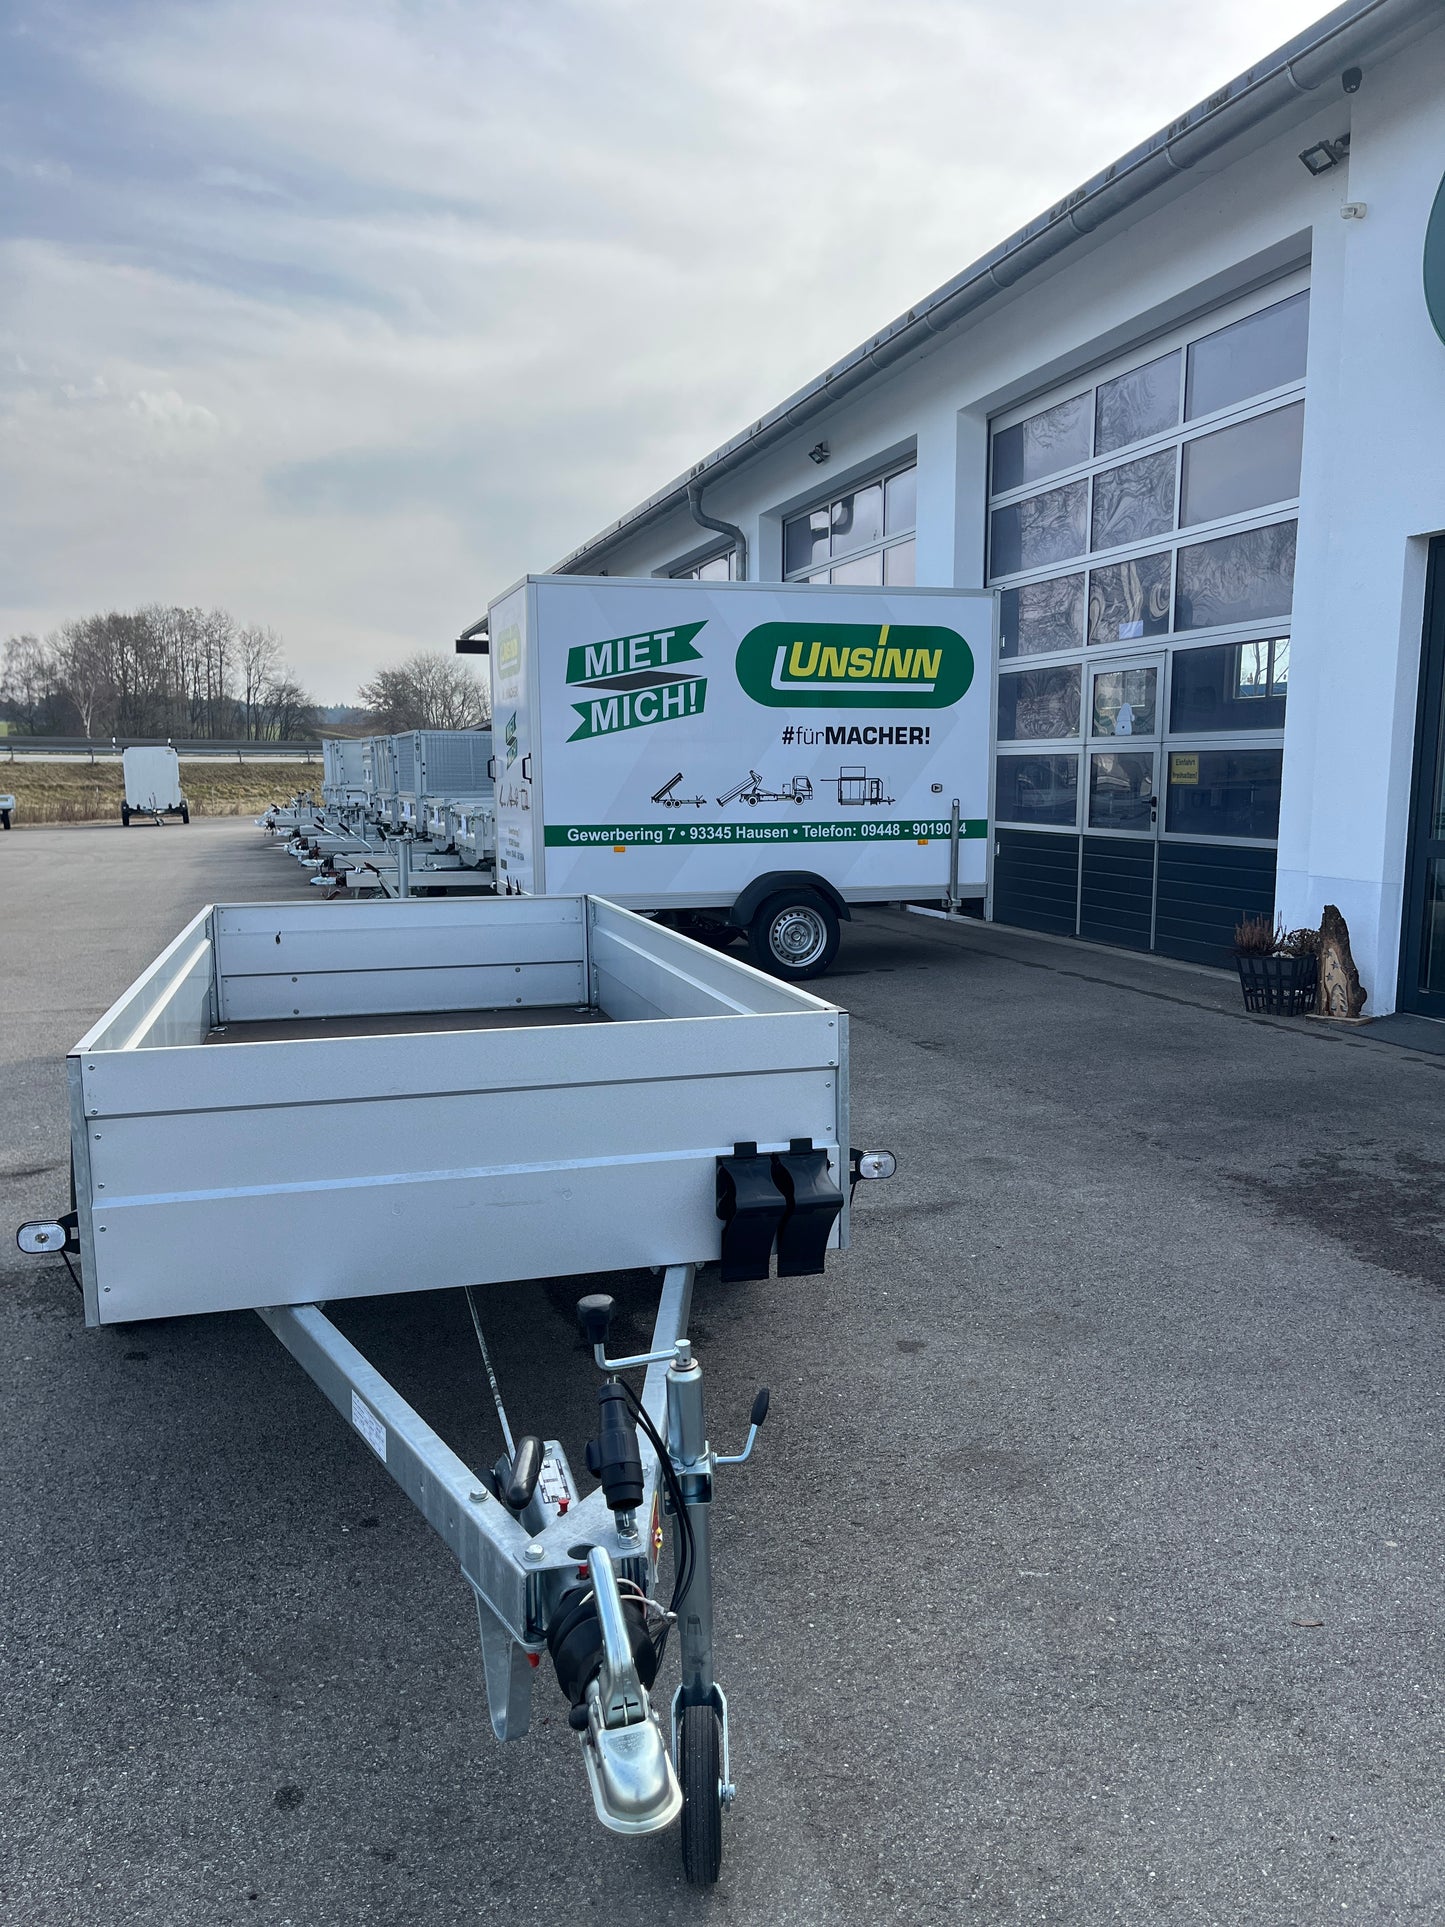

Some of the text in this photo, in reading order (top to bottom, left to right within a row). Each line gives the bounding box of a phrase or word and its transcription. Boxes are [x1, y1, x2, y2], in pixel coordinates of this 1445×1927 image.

[585, 630, 676, 678] MIET
[591, 682, 697, 733] MICH!
[781, 725, 930, 745] #fürMACHER!
[567, 827, 663, 843] Gewerbering
[667, 827, 676, 840] 7
[689, 826, 732, 840] 93345
[736, 825, 789, 839] Hausen
[802, 823, 856, 838] Telefon:
[861, 823, 900, 836] 09448
[912, 822, 967, 836] 901904
